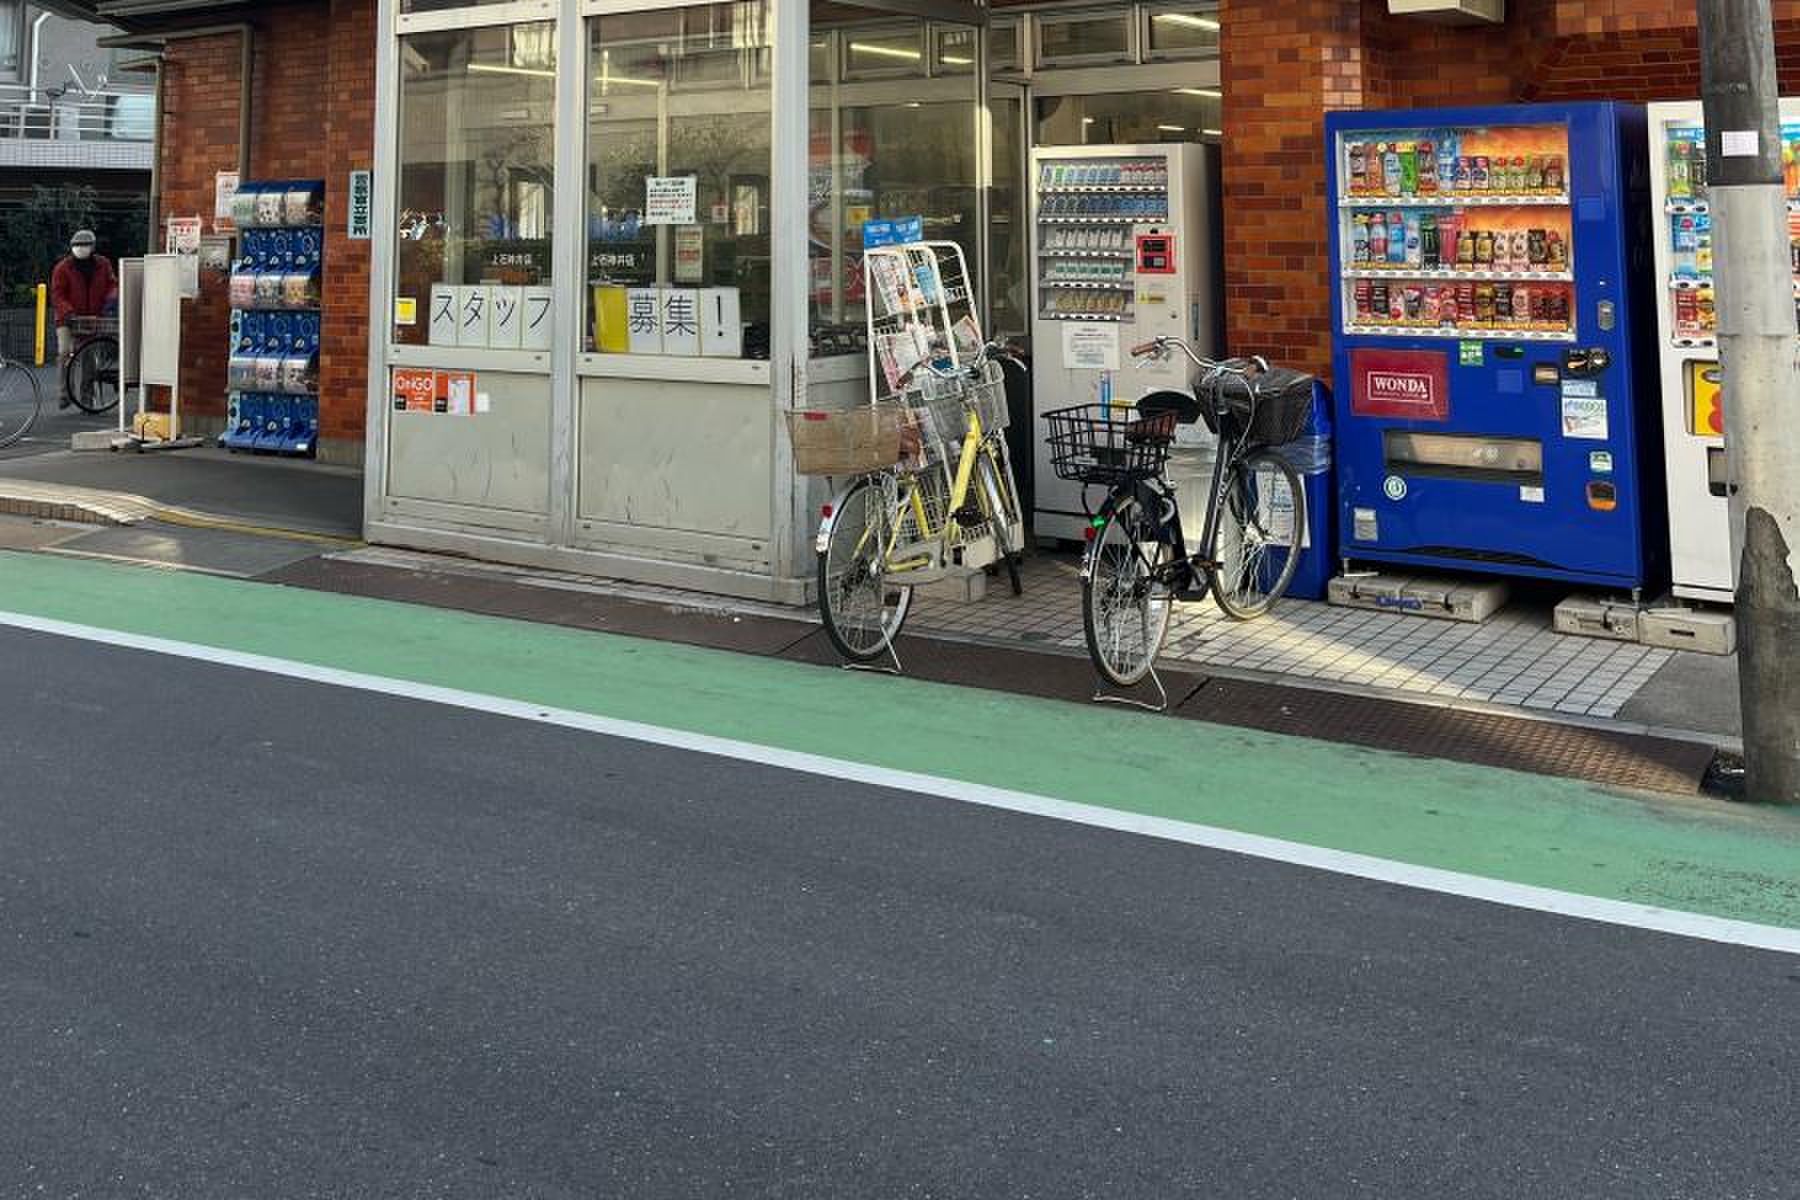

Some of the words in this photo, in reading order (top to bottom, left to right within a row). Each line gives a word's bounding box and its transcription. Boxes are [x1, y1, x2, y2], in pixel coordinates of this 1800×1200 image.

[432, 290, 551, 330] スタッフ
[1373, 376, 1428, 395] WONDA
